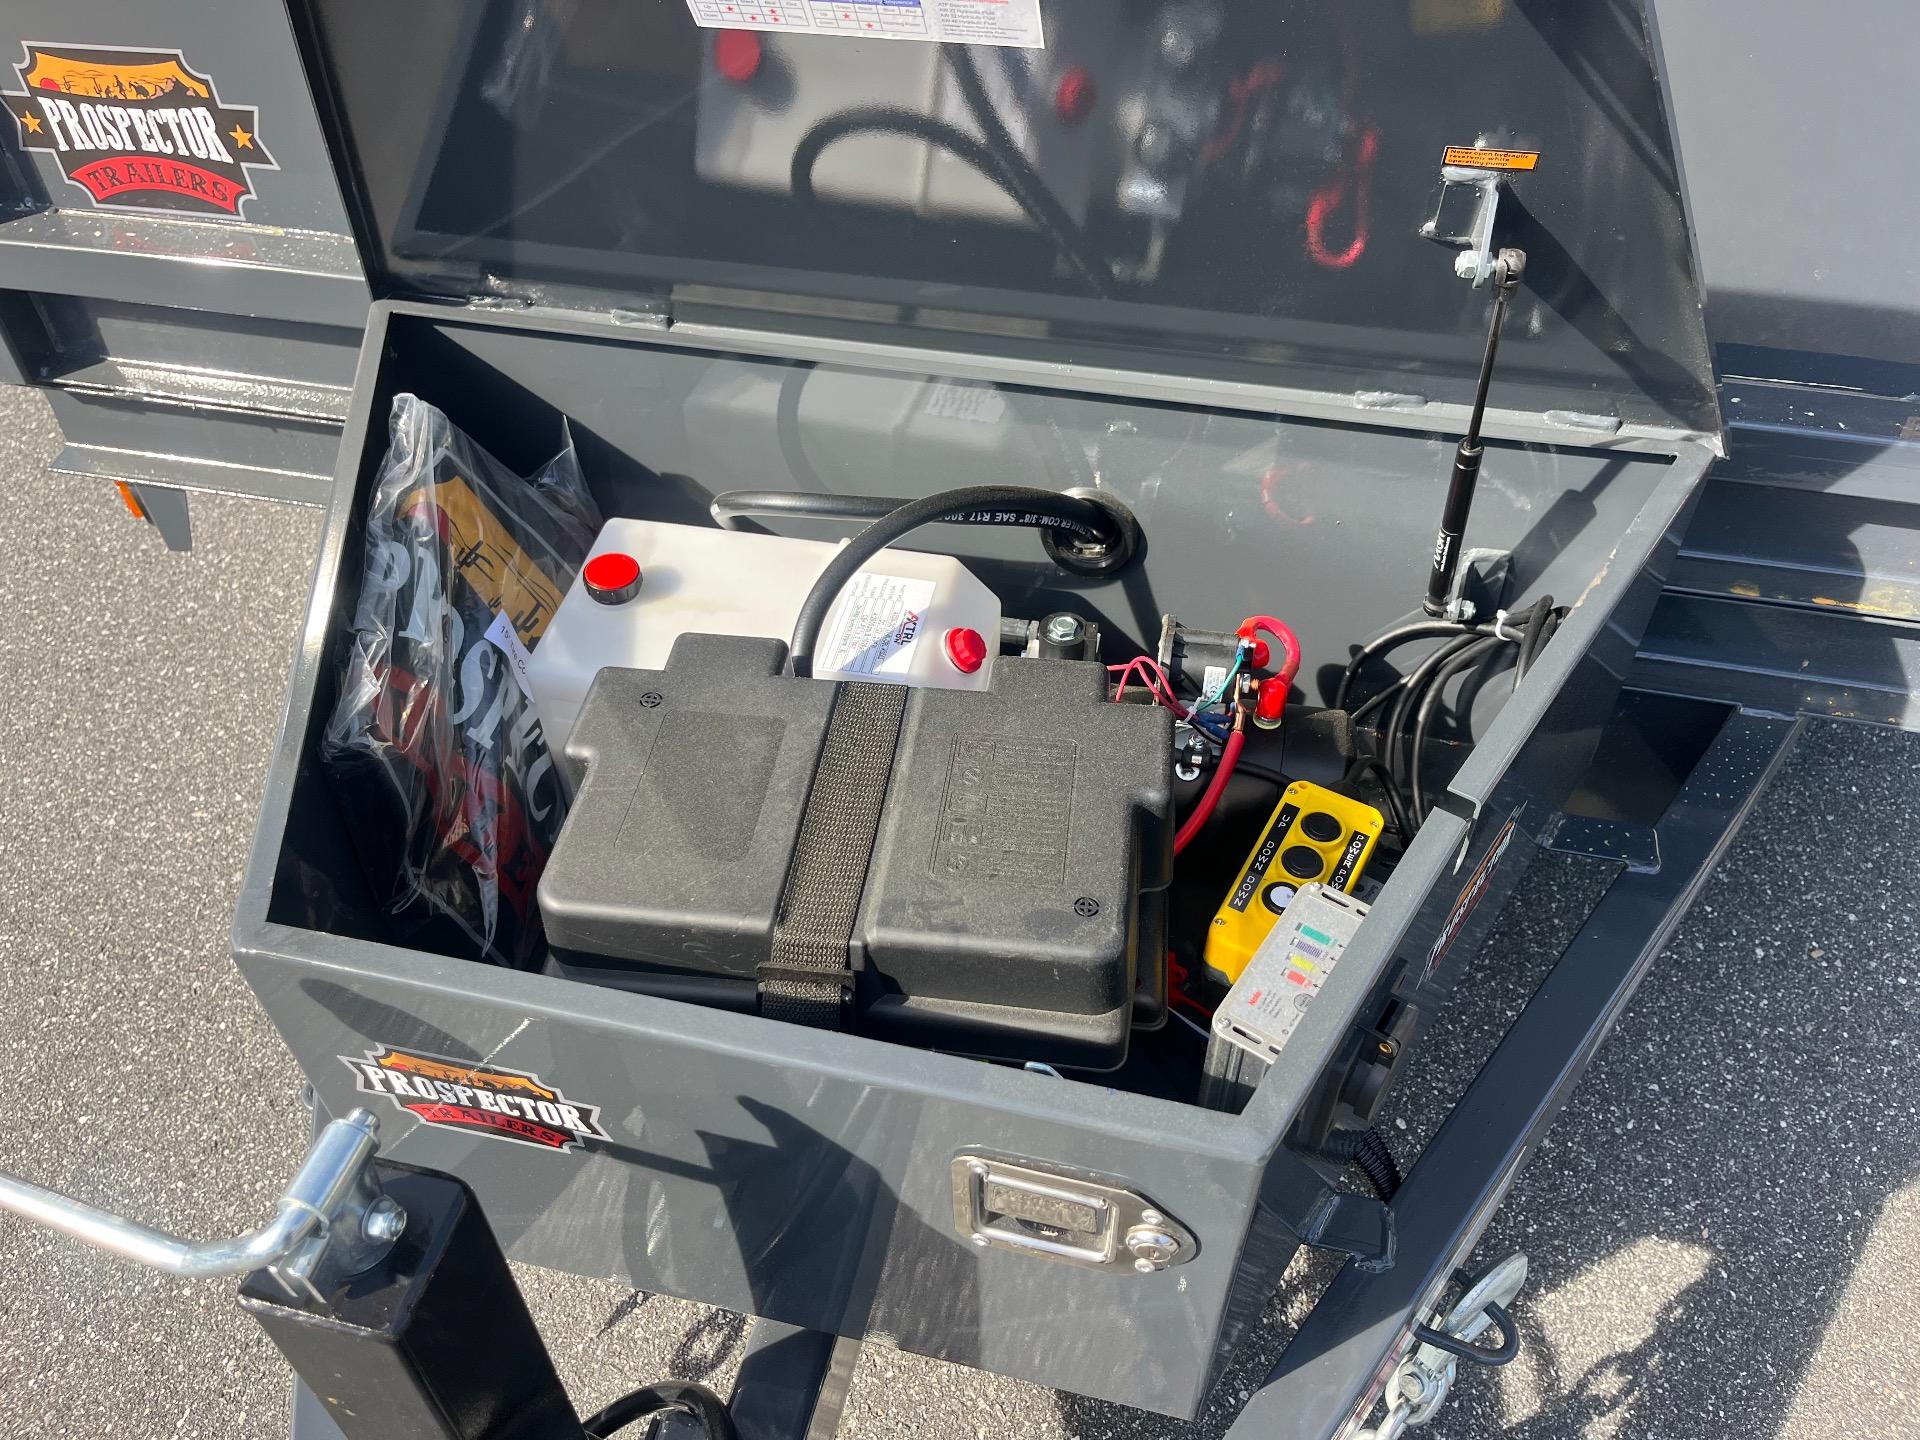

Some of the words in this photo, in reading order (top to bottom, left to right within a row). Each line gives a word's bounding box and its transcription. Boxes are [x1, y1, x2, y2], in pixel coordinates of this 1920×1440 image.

[37, 96, 234, 164] PROSPECTOR
[88, 163, 228, 202] TRAILERS
[969, 511, 991, 522] R17
[994, 512, 1017, 523] SAE
[1018, 514, 1038, 524] 3/8"
[1278, 814, 1290, 828] UP
[1254, 840, 1274, 870] DOWN
[1343, 834, 1364, 868] POWER
[1234, 876, 1255, 906] DOWN
[1332, 869, 1347, 890] POW
[361, 1064, 592, 1134] PROSPECTOR
[422, 1107, 556, 1143] TRAILERS
